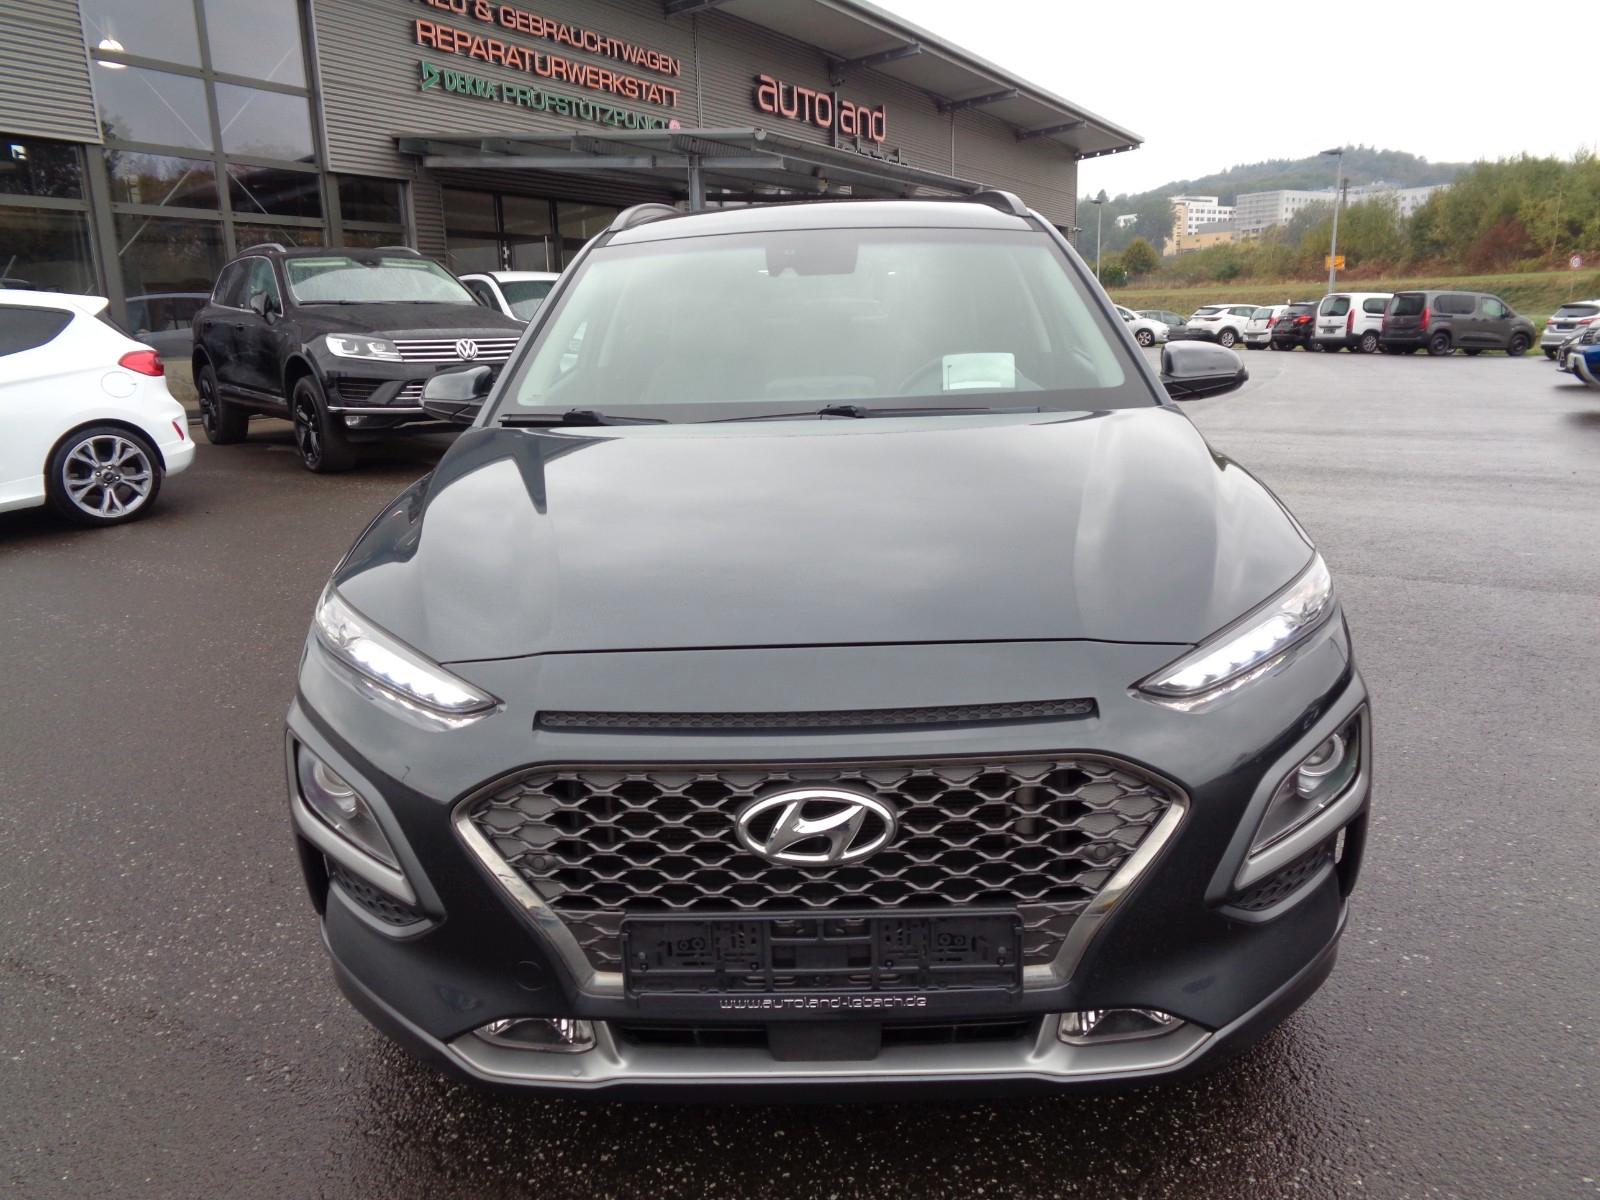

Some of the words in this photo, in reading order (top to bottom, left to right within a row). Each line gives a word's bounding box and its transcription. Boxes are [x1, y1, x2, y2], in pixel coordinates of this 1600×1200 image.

[415, 18, 681, 108] REPARATURWERKSTATT
[474, 0, 494, 23] &
[499, 5, 681, 77] GEBRAUCHTWAGEN
[443, 68, 498, 101] DEKRA
[719, 995, 928, 1010] www.autoland-lebach.de
